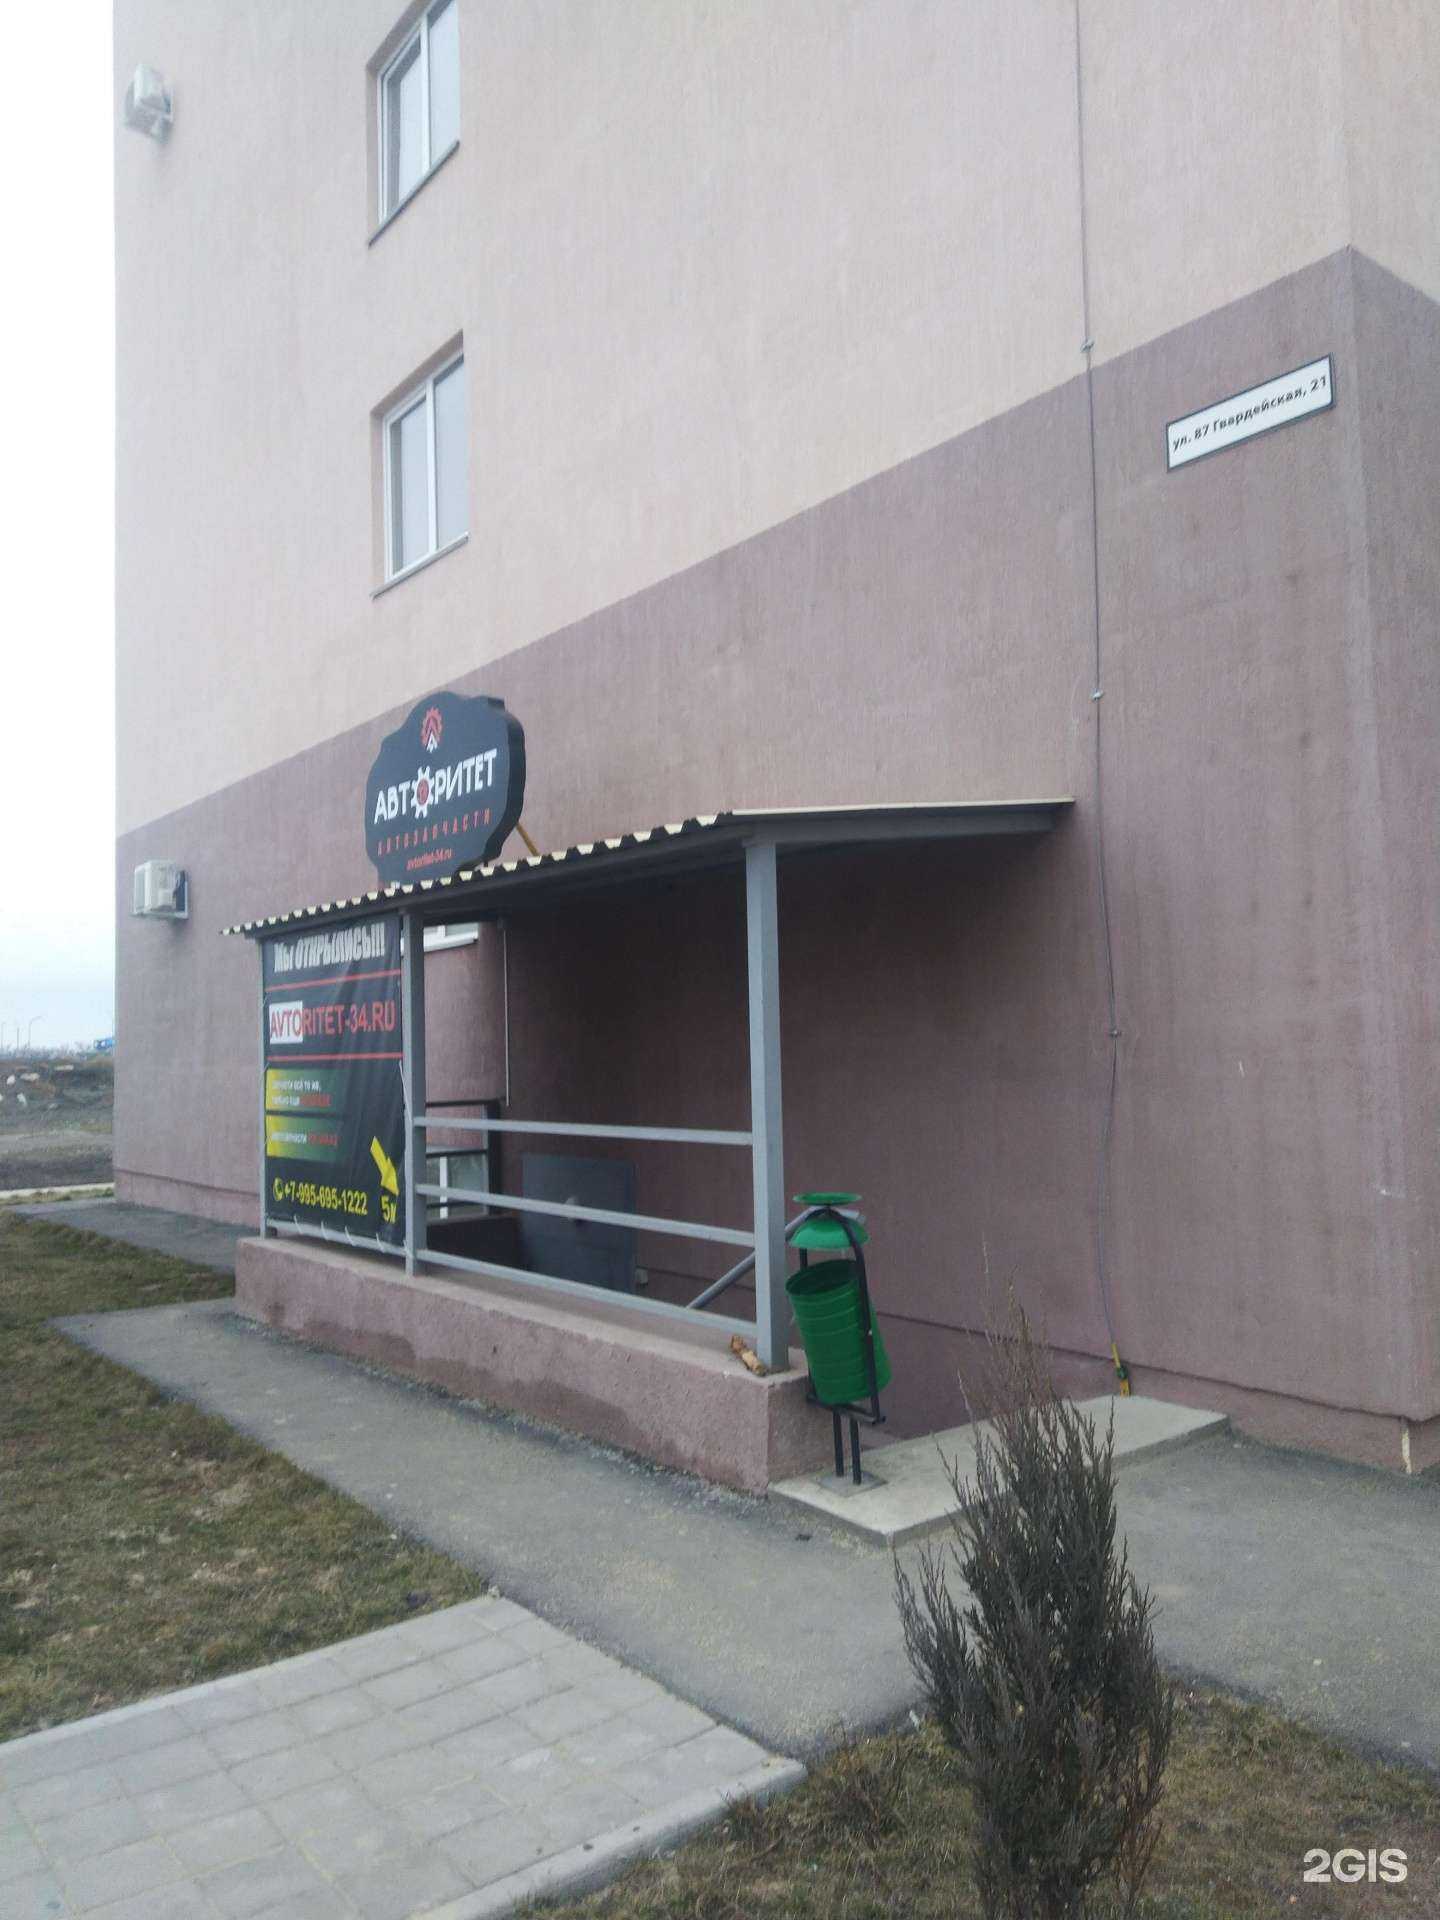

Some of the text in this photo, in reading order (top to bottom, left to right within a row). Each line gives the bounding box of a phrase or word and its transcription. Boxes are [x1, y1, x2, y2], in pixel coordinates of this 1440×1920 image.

[1173, 436, 1191, 451] ул.
[1194, 423, 1210, 440] 87
[1310, 376, 1327, 392] 21
[373, 748, 498, 824] АВТОРИТЕТ
[270, 999, 396, 1038] AVTORITET-34.RU
